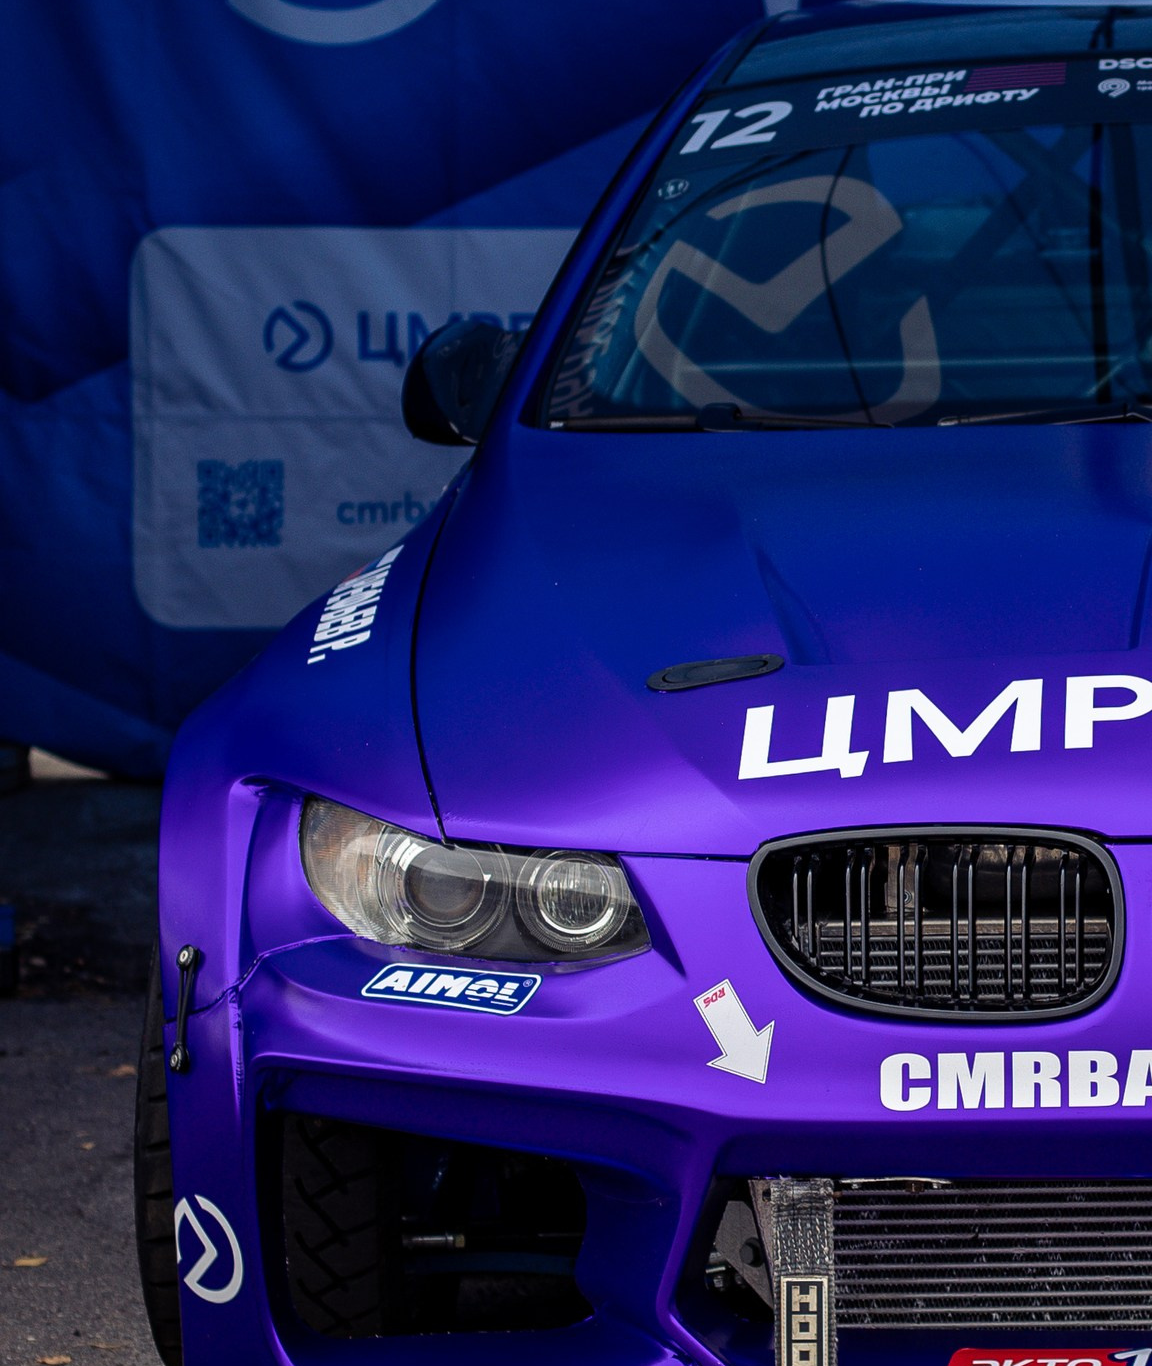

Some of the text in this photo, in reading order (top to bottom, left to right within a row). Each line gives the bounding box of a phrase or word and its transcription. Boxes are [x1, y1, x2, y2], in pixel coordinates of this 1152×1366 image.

[814, 83, 951, 113] МОСКВЫ
[816, 69, 967, 101] ГРАН-ПРИ
[858, 88, 1040, 119] ПО ДРИФТУ
[679, 100, 793, 155] 12
[336, 491, 437, 525] cmrb
[371, 970, 520, 1007] AIMOL
[702, 987, 726, 1009] RDS
